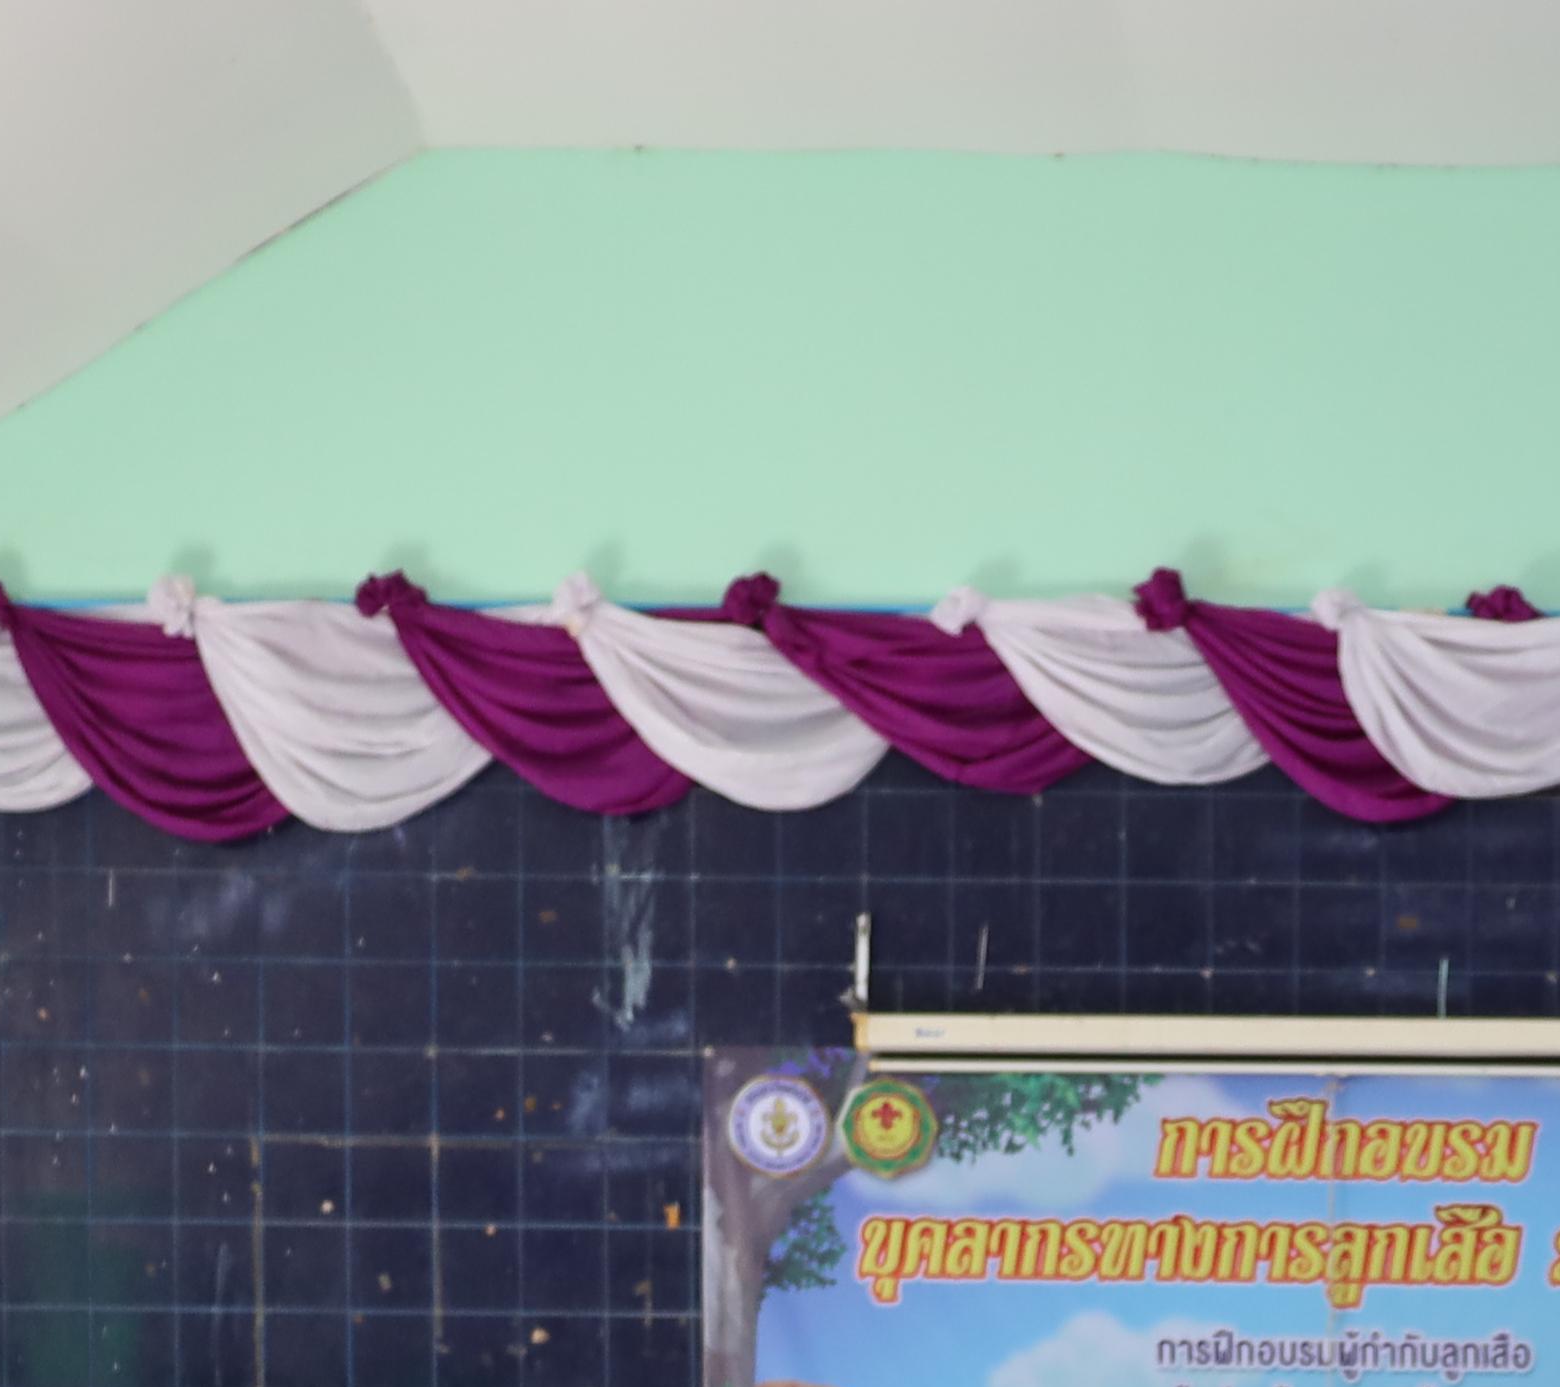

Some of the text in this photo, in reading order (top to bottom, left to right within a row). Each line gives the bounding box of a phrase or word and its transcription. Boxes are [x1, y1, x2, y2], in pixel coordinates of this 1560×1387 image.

[1154, 1097, 1537, 1182] การฝึกอบรม
[858, 1205, 1523, 1309] บุคลากรทางการลูกเสือ
[1157, 1329, 1531, 1381] การฝึกอบรมผู้กำกับลูกเสือ
